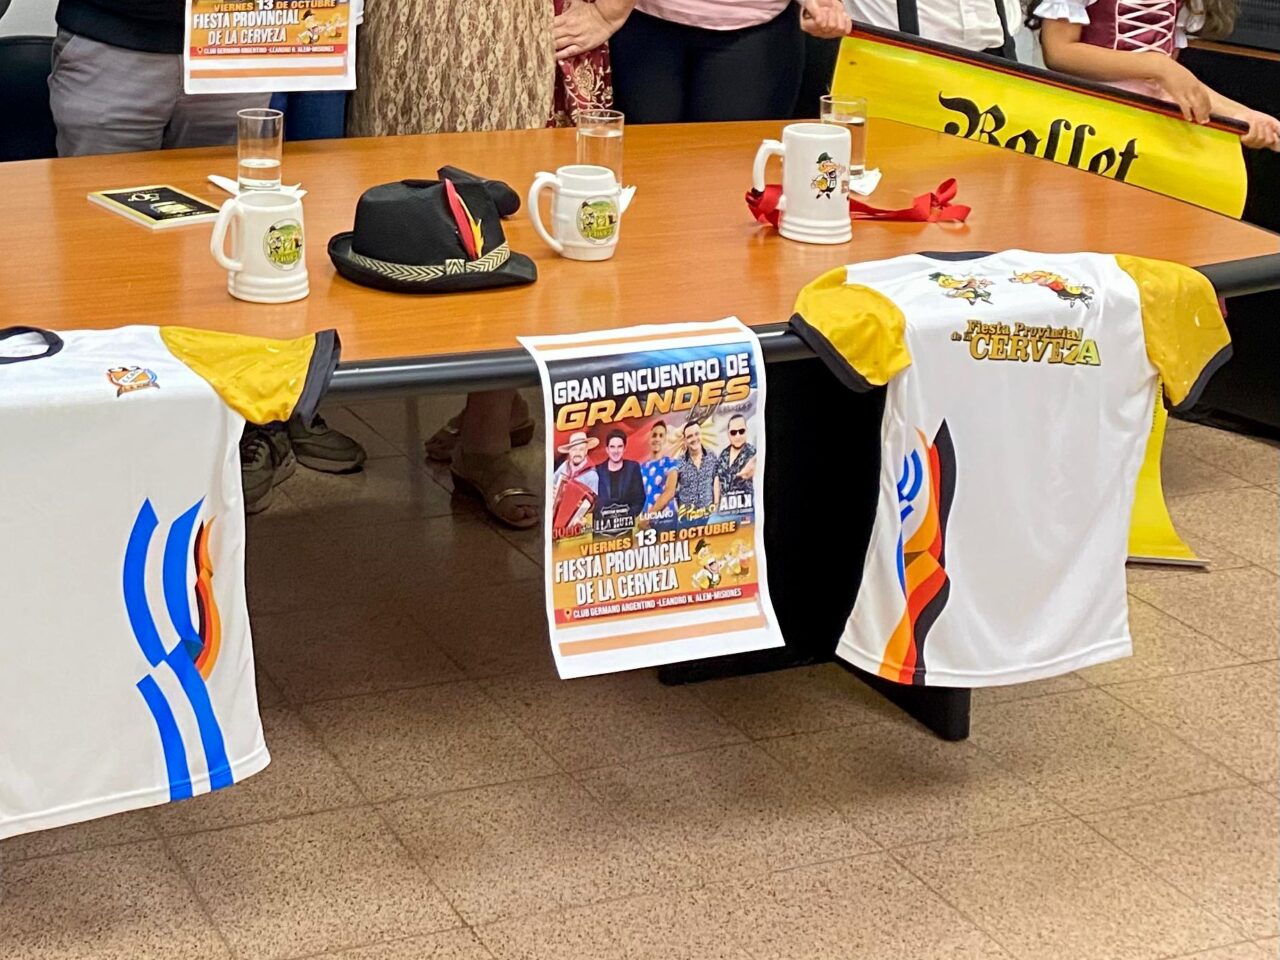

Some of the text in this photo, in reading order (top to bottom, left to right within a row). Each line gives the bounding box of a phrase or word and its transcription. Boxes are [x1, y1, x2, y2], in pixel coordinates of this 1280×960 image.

[193, 9, 300, 29] FIESTA PROVINCIAL
[214, 2, 253, 12] VIERNES
[276, 0, 289, 9] DE
[208, 27, 287, 45] DE LA CERVEZA
[951, 331, 962, 341] de
[966, 320, 1083, 340] Fiesta Provincial
[970, 334, 1101, 366] CERVEZA
[553, 352, 750, 405] GRAN ENCUENTRO DE
[556, 375, 751, 432] GRANDES
[580, 521, 736, 556] VIERNES 13 DE OCTUBRE
[555, 540, 692, 584] FIESTA PROVINCIAL
[576, 567, 680, 606] DE LA CERVEZA
[573, 609, 589, 619] CLUB
[590, 604, 620, 617] GERMANO
[621, 600, 655, 612] ARGENTINO
